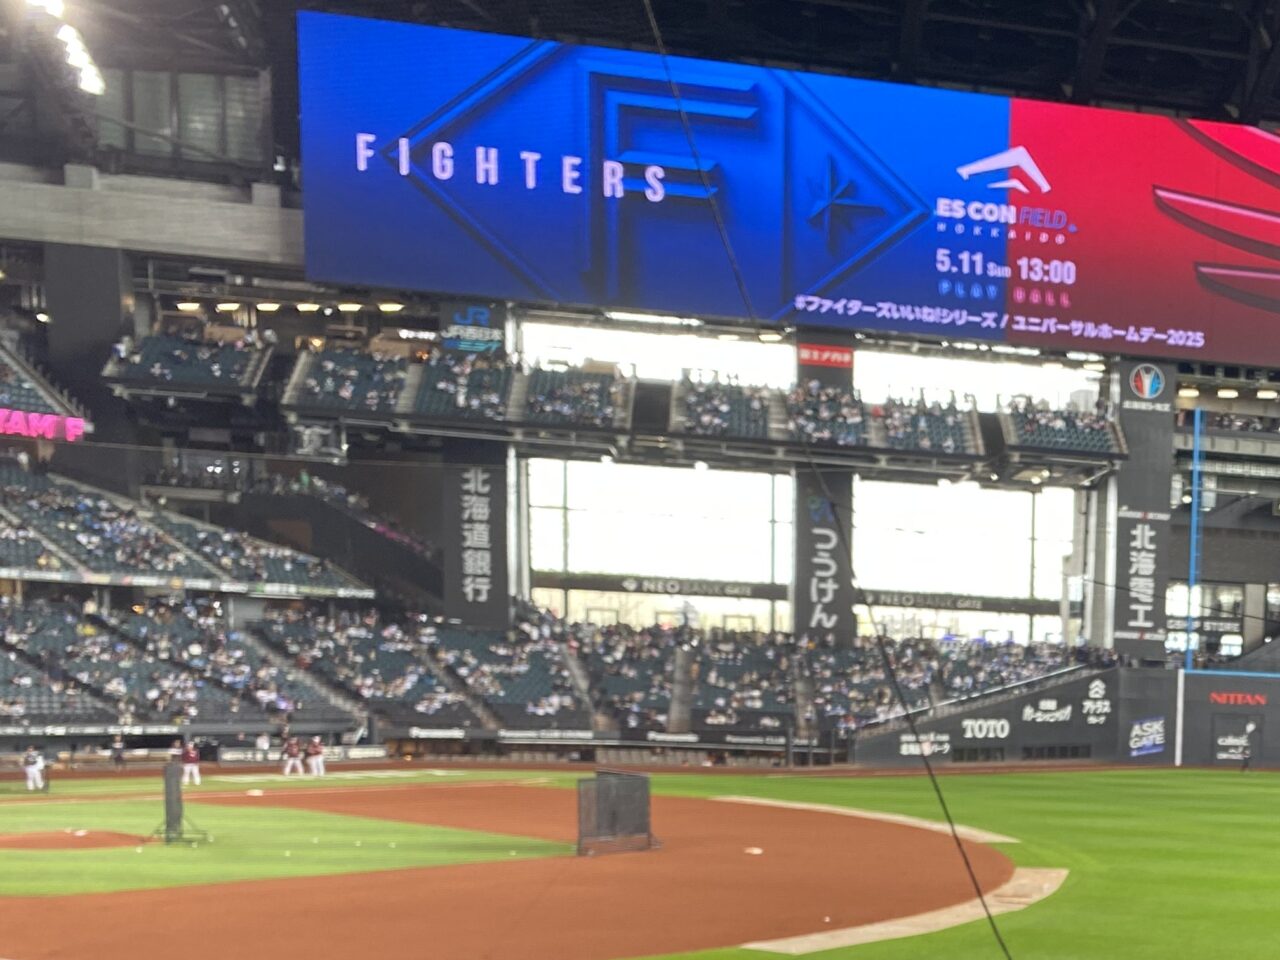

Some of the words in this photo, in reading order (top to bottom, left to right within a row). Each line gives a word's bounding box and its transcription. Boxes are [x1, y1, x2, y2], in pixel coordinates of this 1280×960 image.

[356, 133, 665, 202] FIGHTERS
[936, 222, 1066, 245] HOKKAIDO
[936, 248, 983, 276] 5.11
[1016, 256, 1076, 285] 13:00
[462, 467, 492, 603] 北海道銀行
[809, 528, 838, 630] つうけん
[1210, 692, 1267, 705] NITTAN
[961, 718, 1010, 739] TOTO
[1131, 720, 1165, 738] ASK
[1129, 735, 1165, 749] GATE
